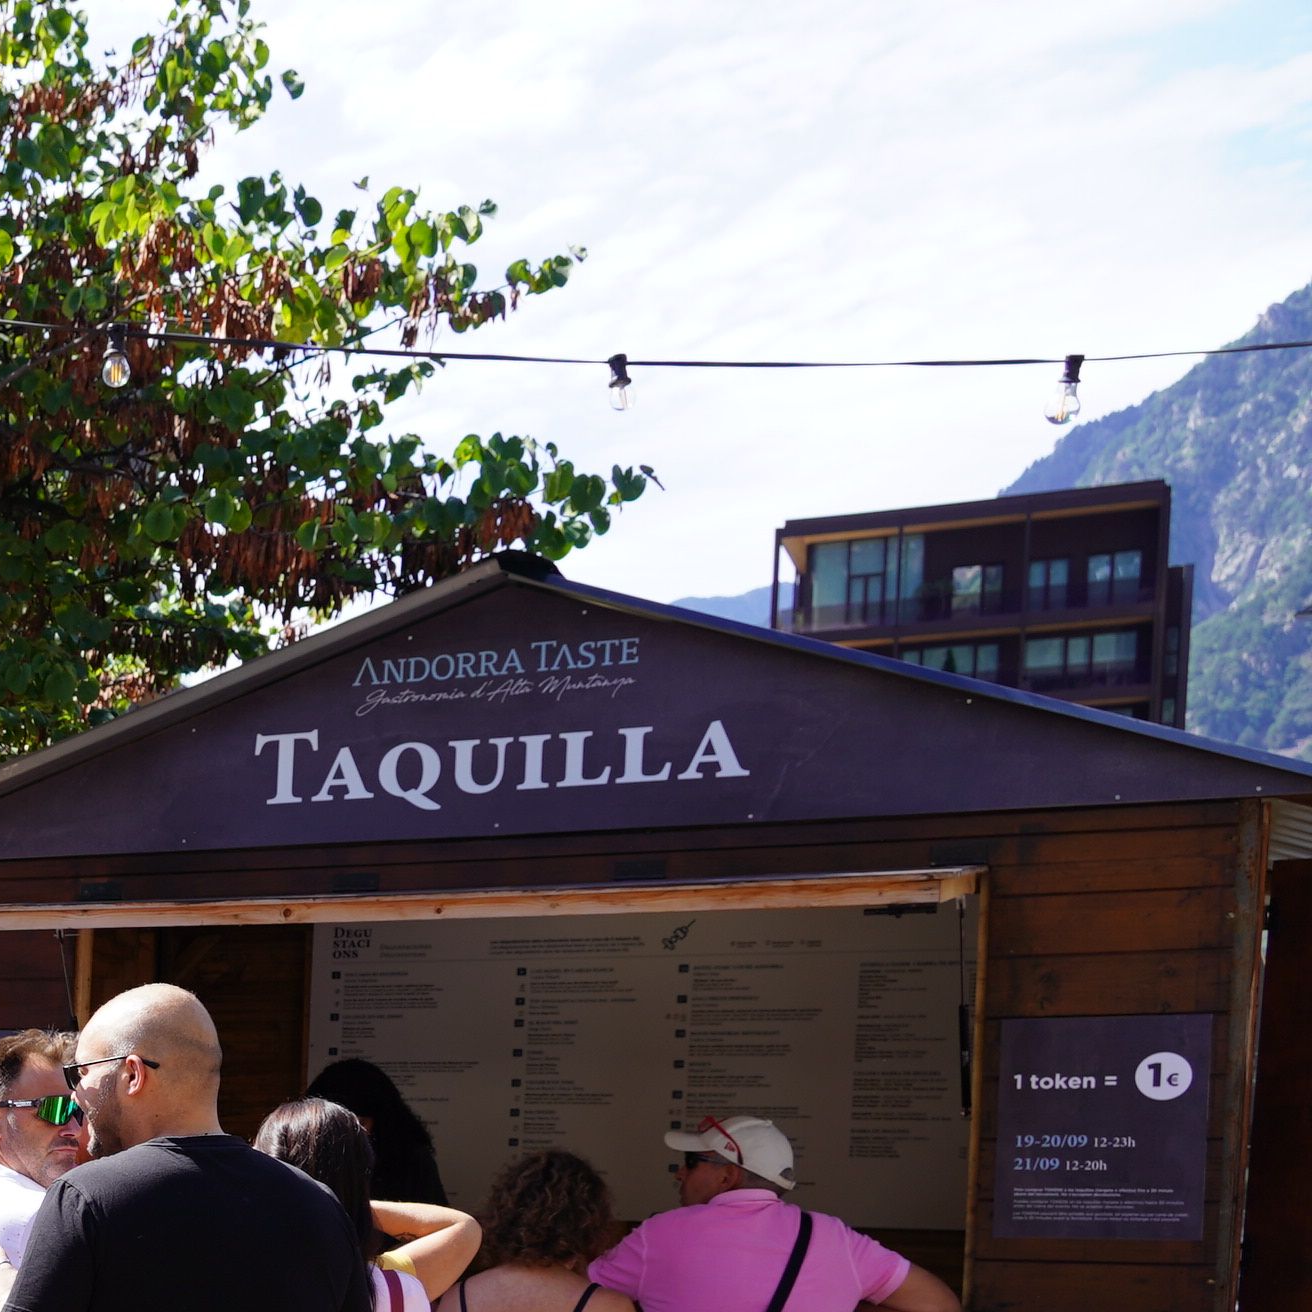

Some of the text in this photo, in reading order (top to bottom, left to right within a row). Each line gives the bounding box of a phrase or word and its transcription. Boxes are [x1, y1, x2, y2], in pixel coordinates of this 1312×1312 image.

[352, 638, 640, 687] ANDORRA TASTE
[355, 673, 637, 717] Gastronomia d'Alta Muntanya
[255, 719, 750, 811] TAQUILLA
[1013, 1074, 1022, 1090] 1
[1029, 1072, 1096, 1090] token
[1147, 1062, 1180, 1088] 1€
[1014, 1134, 1136, 1149] 19-20/09 12-23h
[1013, 1157, 1107, 1171] 21/09 12-20h
